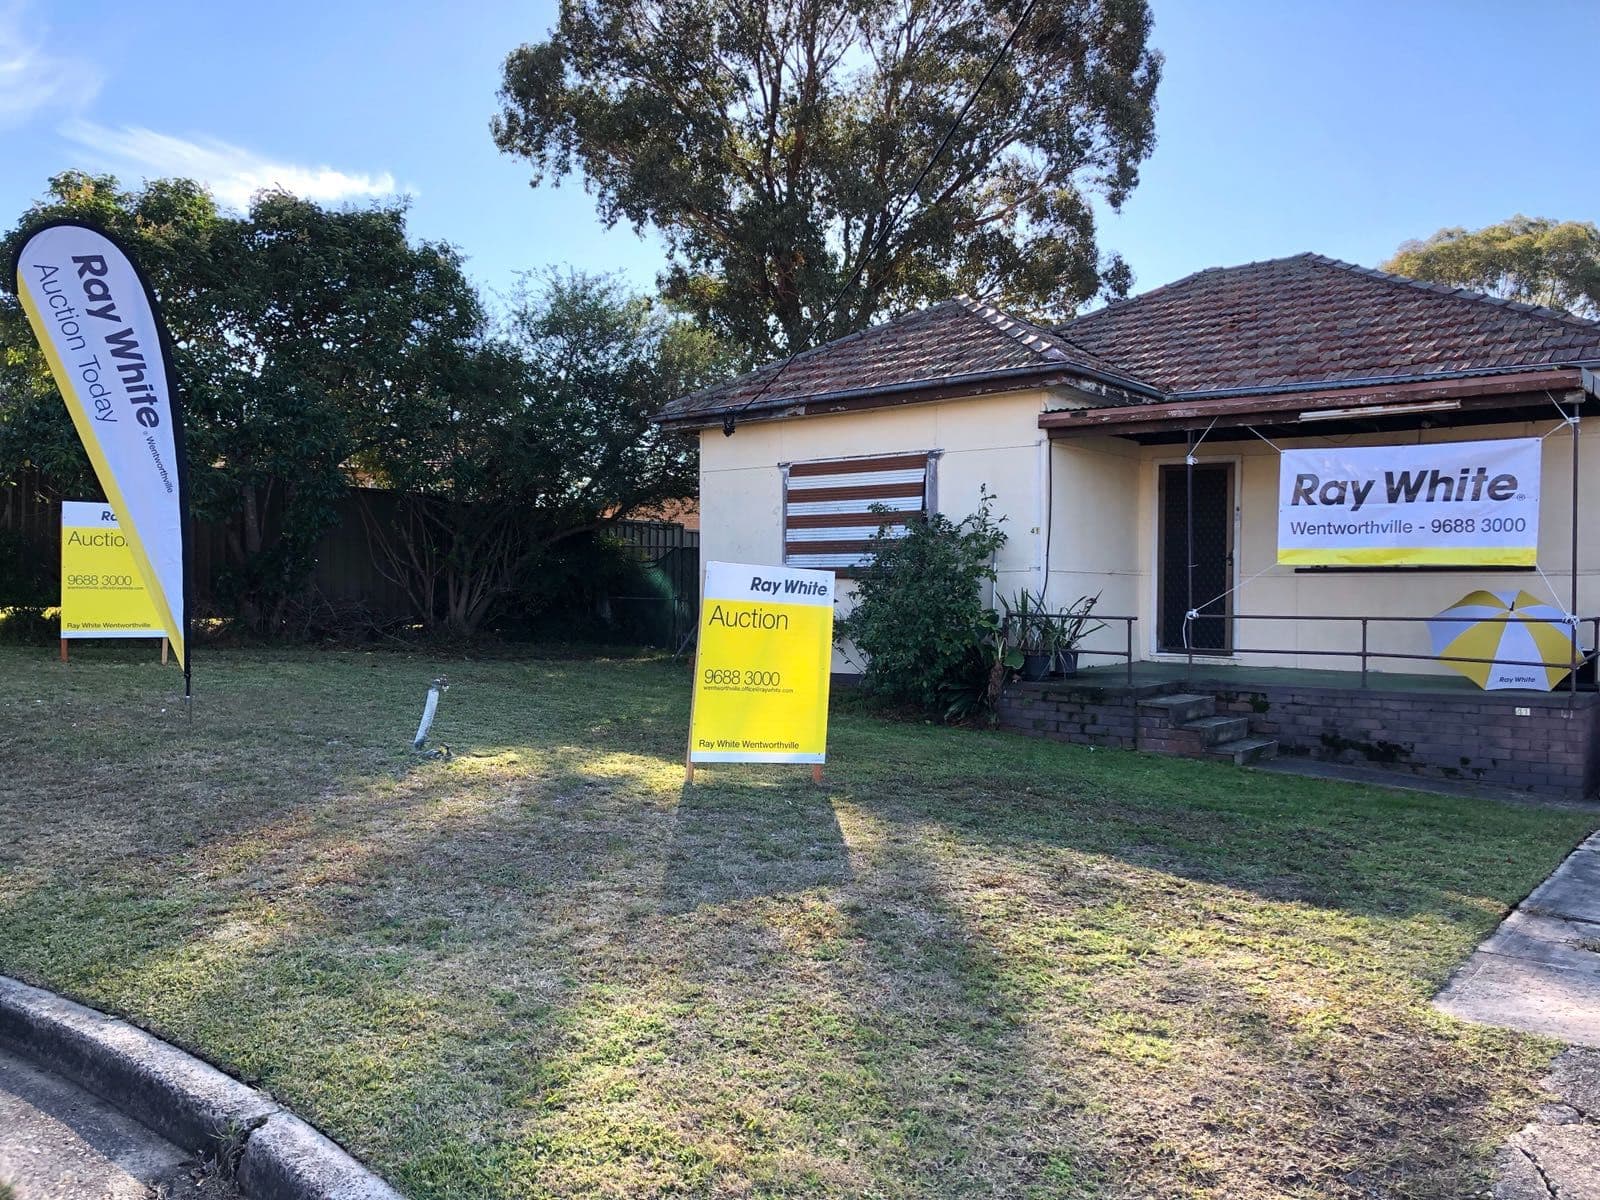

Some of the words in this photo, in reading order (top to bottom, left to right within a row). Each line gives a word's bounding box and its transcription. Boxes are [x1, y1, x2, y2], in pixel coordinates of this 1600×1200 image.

[33, 264, 86, 351] Auction
[78, 354, 118, 422] Today
[71, 255, 122, 323] Ray
[146, 436, 174, 494] Wentworthville
[1290, 473, 1376, 512] Ray
[1290, 519, 1413, 536] Wentworthville
[1431, 518, 1476, 534] 9688
[1481, 517, 1526, 533] 3000
[68, 531, 129, 547] Auctio
[67, 574, 99, 586] 9688
[101, 575, 133, 586] 3000
[750, 577, 782, 595] Ray
[784, 579, 828, 596] White
[709, 605, 788, 630] Auction
[704, 669, 741, 685] 9688
[744, 671, 780, 687] 3000
[1499, 676, 1513, 684] Ray
[699, 739, 714, 749] Ray
[716, 739, 741, 749] White
[742, 739, 800, 749] Wentworthville
